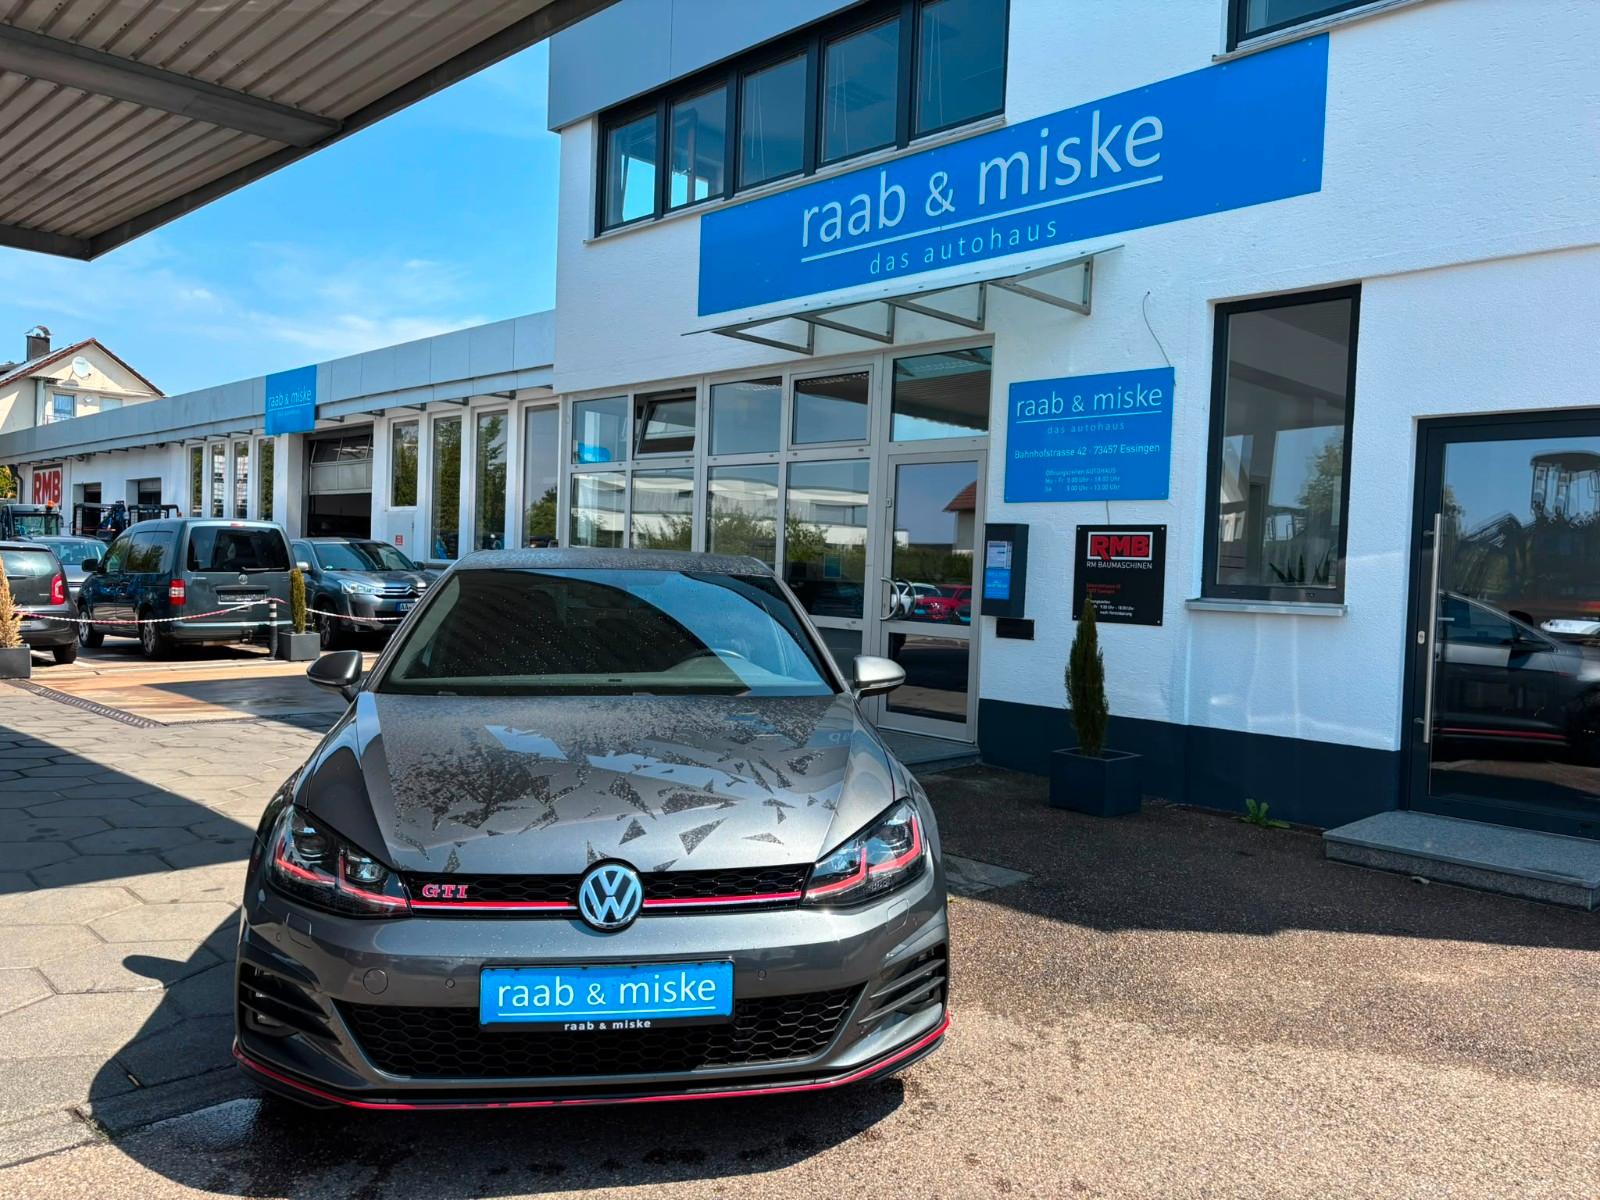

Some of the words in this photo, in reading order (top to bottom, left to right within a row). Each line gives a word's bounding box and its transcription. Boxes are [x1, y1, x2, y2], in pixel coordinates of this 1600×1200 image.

[802, 171, 906, 248] raab
[925, 171, 955, 217] &
[978, 110, 1163, 206] miske
[869, 252, 909, 275] das
[924, 220, 1057, 263] autohaus
[1016, 391, 1064, 417] raab
[1071, 395, 1085, 413] &
[1093, 383, 1163, 410] miske
[1047, 425, 1065, 434] das
[1070, 422, 1125, 433] autohaus
[1014, 448, 1075, 459] Bahnhofstrasse
[1077, 447, 1087, 456] 42
[1093, 444, 1118, 454] 73457
[1120, 443, 1160, 455] Essingen
[34, 470, 61, 505] RMB
[1090, 535, 1149, 560] RMB
[1098, 561, 1153, 569] BAUMASCHINEN
[422, 883, 469, 899] GTI
[498, 975, 575, 1008] raab
[587, 985, 606, 1006] &
[620, 971, 717, 1004] miske
[564, 1021, 594, 1031] raab
[599, 1021, 607, 1030] &
[612, 1020, 652, 1030] miske
